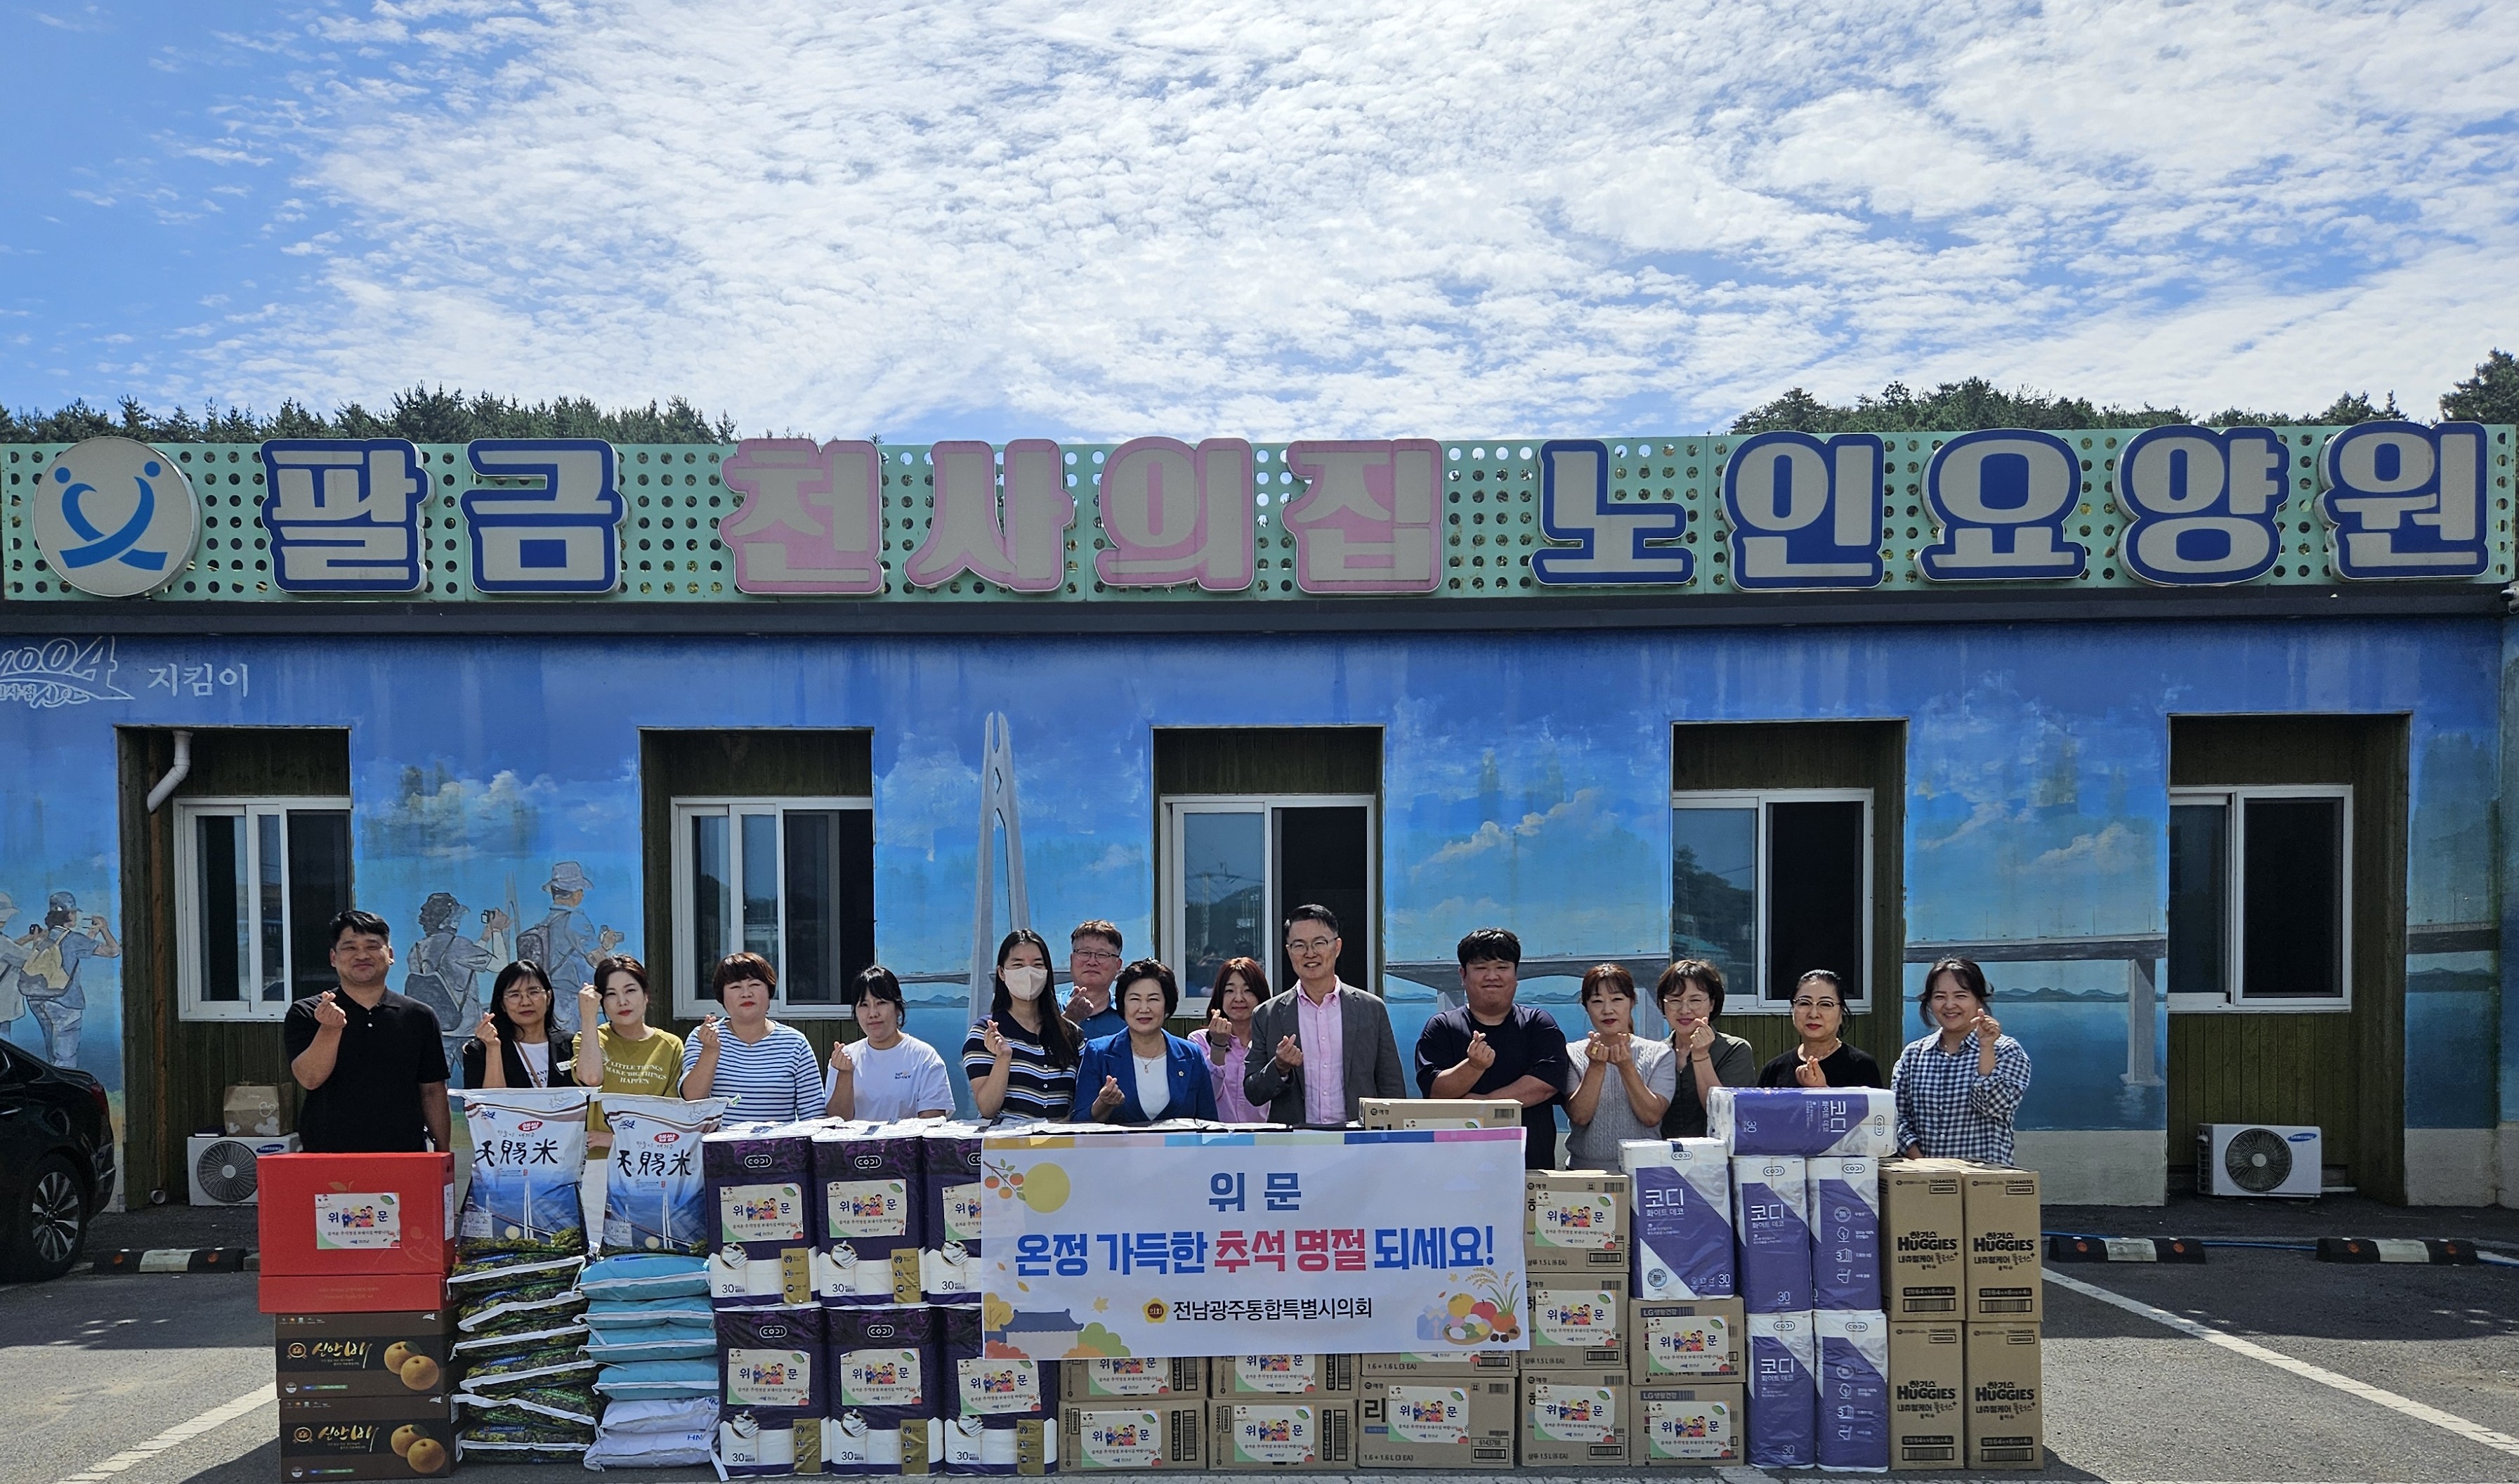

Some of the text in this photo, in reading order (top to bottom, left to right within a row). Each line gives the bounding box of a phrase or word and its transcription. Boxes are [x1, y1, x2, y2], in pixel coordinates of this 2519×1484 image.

[261, 438, 628, 593] 팔금
[1531, 421, 2489, 591] 노인요양원
[148, 663, 249, 697] 지킴이
[606, 1065, 627, 1076] MAKE
[641, 1071, 667, 1080] THINGS
[610, 1061, 663, 1072] LITTLE THINGS
[1831, 1101, 1846, 1133] 코디
[1746, 1120, 1757, 1133] 30
[1209, 1172, 1301, 1212] 위 문
[1645, 1188, 1684, 1207] 코디
[733, 1202, 791, 1216] 위 문
[839, 1199, 897, 1212] 위 문
[955, 1203, 965, 1214] 위
[328, 1211, 388, 1223] 위 문
[1547, 1210, 1604, 1223] 위 문
[1646, 1208, 1668, 1217] 화이트
[1751, 1204, 1784, 1221] 코디
[1897, 1237, 1957, 1251] HUGGIES
[1973, 1237, 2034, 1252] HUGGIES
[1015, 1226, 1494, 1276] 온정 가득한 추석 명절 되세요!
[1718, 1273, 1730, 1284] 30
[722, 1284, 735, 1294] 30
[832, 1283, 844, 1293] 30
[941, 1280, 955, 1290] 30
[1778, 1291, 1791, 1302] 30
[1172, 1297, 1373, 1321] 전남광주통합특별시의회
[1547, 1309, 1604, 1320] 위 문
[1660, 1335, 1718, 1347] 위 문
[311, 1341, 373, 1369] 신안배
[1246, 1355, 1303, 1366] 위 문
[1099, 1358, 1156, 1369] 위 문
[1761, 1358, 1793, 1374] 코디
[739, 1367, 798, 1379] 위 문
[852, 1367, 909, 1379] 위 문
[970, 1374, 1028, 1389] 위 문
[1909, 1380, 1937, 1388] 하기스
[1897, 1386, 1956, 1400] HUGGIES
[1975, 1387, 2035, 1401] HUGGIES
[1399, 1405, 1458, 1417] 위 문
[1546, 1404, 1603, 1417] 위 문
[1245, 1424, 1303, 1436] 위 문
[1661, 1421, 1719, 1433] 위 문
[318, 1425, 380, 1452] 신안배
[1092, 1429, 1150, 1441] 위 문
[842, 1451, 853, 1460] 30
[957, 1451, 969, 1460] 30
[1782, 1445, 1795, 1455] 30
[732, 1452, 745, 1462] 30
